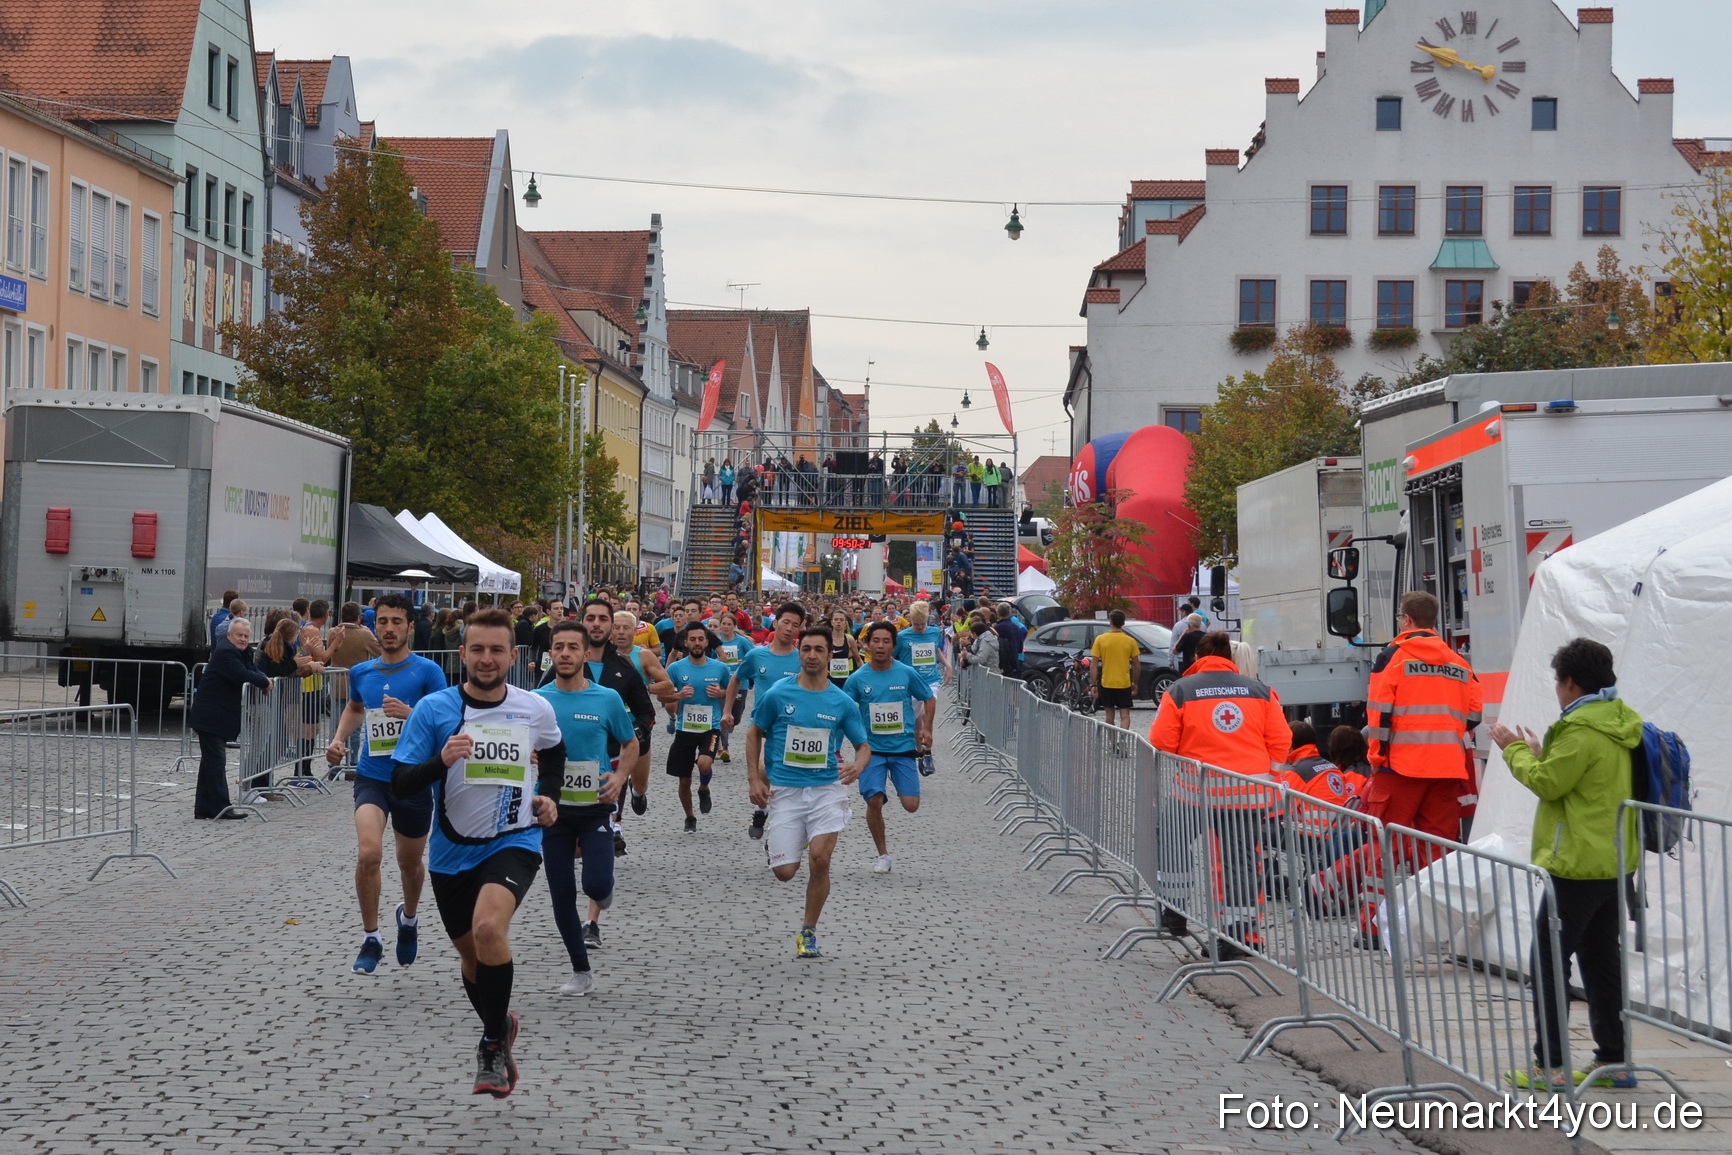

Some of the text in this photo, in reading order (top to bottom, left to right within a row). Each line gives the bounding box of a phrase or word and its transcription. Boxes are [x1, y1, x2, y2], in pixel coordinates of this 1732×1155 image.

[1368, 459, 1398, 513] BOCK
[224, 486, 290, 520] OFFICE INDUSTRY LOUNGE
[301, 483, 337, 546] BOCK
[833, 516, 874, 530] ZIEL
[1409, 663, 1464, 679] NOTARZT
[1195, 687, 1249, 697] BEREITSCHAFTEN
[1214, 703, 1240, 715] DEUTSCHES
[574, 713, 599, 721] BOCK
[687, 713, 708, 722] 5186
[817, 713, 837, 721] BOCK
[875, 712, 898, 722] 5196
[372, 721, 404, 738] 5187
[474, 741, 520, 762] 5065
[791, 738, 822, 752] 5180
[484, 766, 509, 775] Michael
